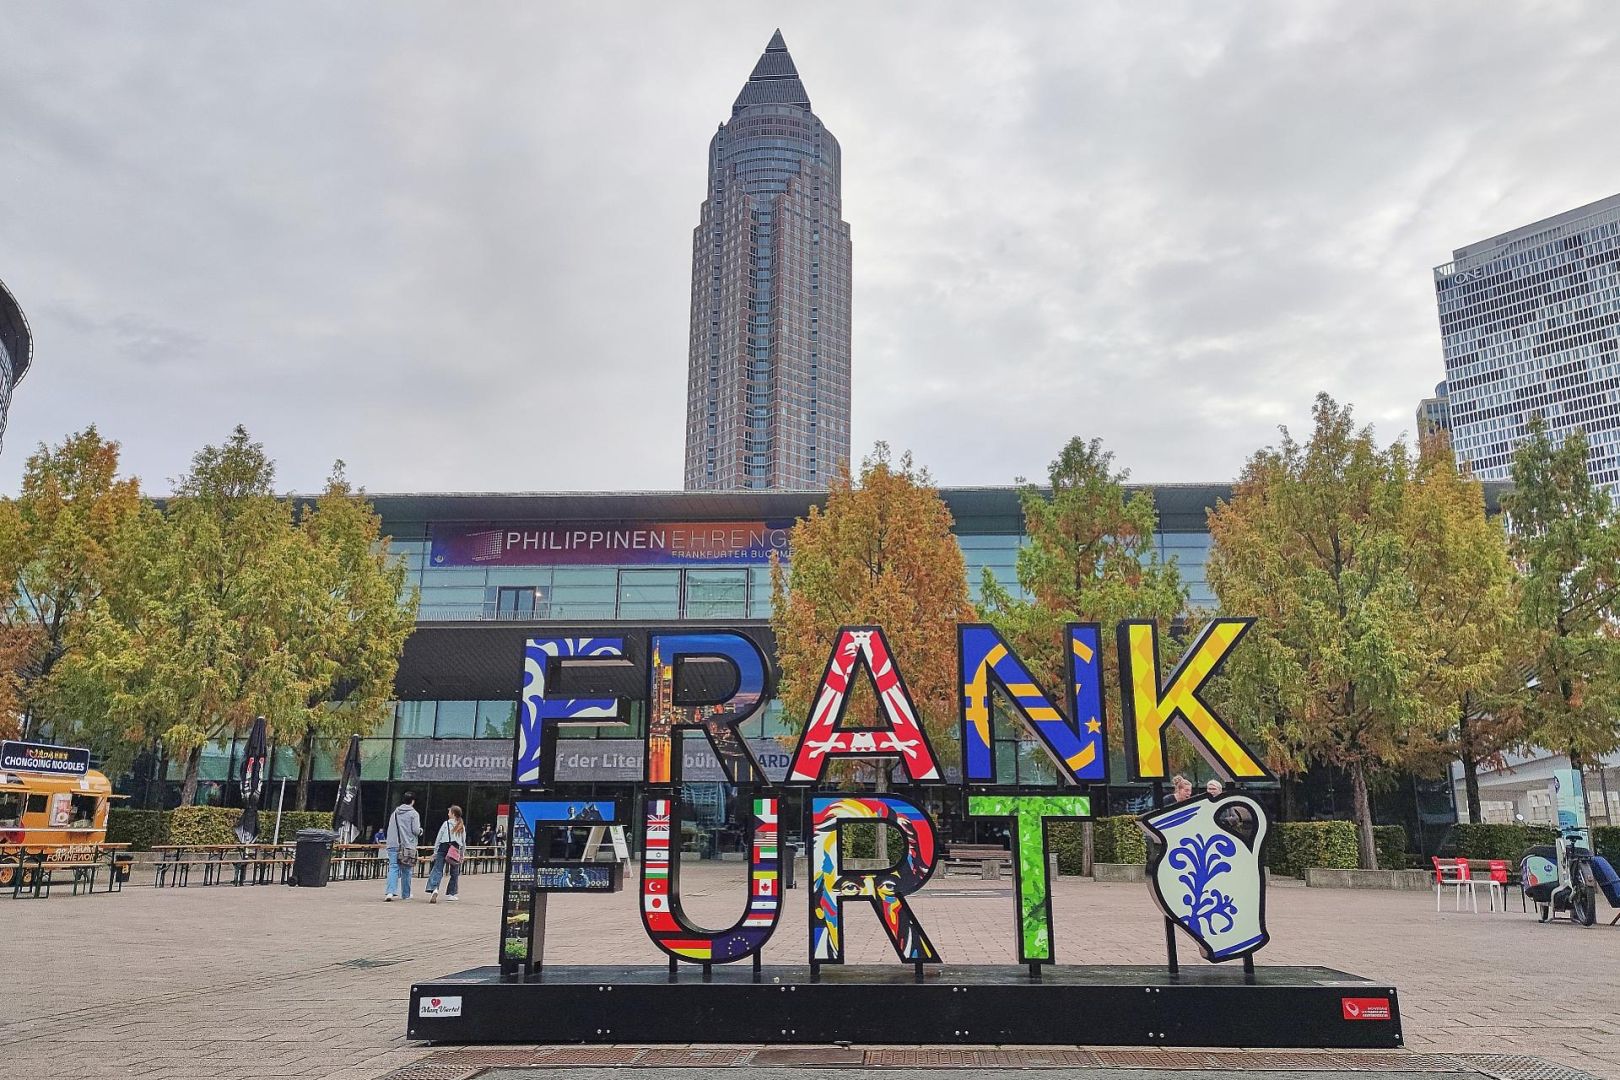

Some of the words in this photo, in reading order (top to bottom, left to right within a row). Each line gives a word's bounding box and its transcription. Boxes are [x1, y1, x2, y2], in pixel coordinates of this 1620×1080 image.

[1455, 267, 1482, 284] ONE
[506, 530, 666, 550] PHILIPPINEN
[672, 529, 788, 549] EHRENG
[672, 550, 748, 559] FRANKFURTER
[751, 549, 796, 559] BUCME
[515, 617, 1279, 788] FRANK
[4, 756, 51, 769] CHONGQING
[52, 760, 85, 771] NOODLES
[417, 753, 513, 768] Willkomme
[567, 753, 598, 768] der
[758, 754, 790, 768] ARD
[500, 793, 1097, 965] FURT
